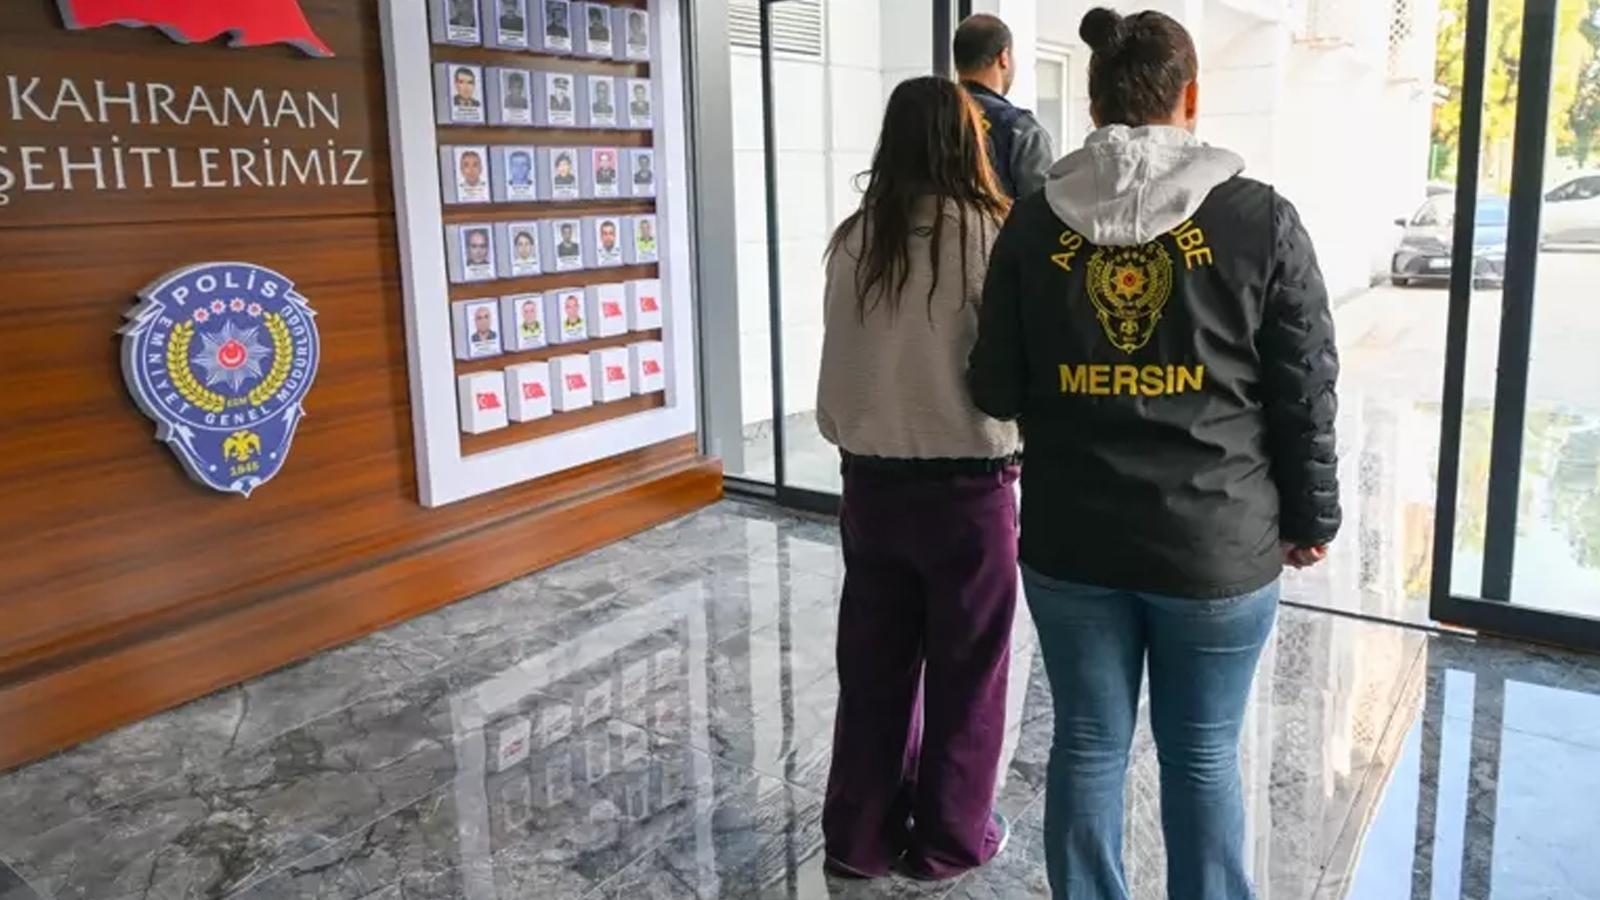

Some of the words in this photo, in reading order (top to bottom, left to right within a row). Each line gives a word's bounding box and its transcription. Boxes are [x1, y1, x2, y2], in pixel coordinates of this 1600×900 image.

[7, 75, 340, 129] KAHRAMAN
[172, 269, 279, 306] POLİS
[204, 405, 271, 427] GENEL
